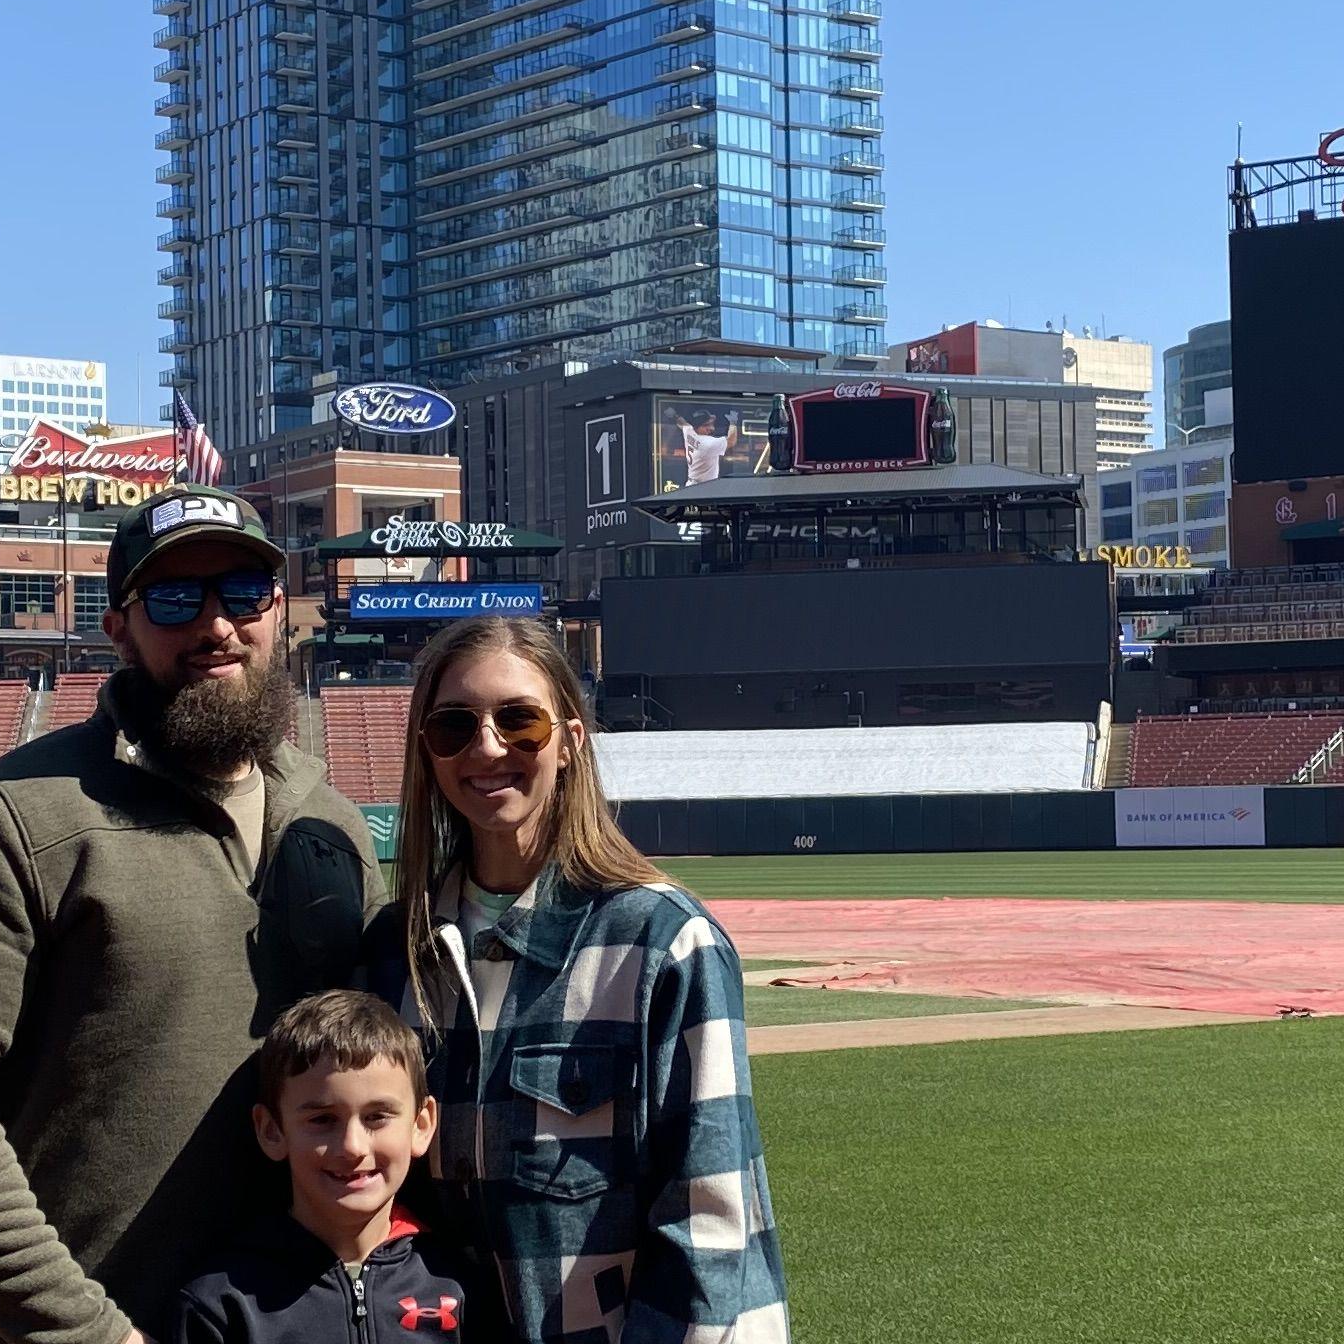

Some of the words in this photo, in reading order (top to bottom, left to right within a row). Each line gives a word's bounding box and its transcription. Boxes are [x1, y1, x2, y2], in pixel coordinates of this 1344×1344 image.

[833, 381, 882, 398] Coca-Cola
[363, 387, 431, 424] Ford
[1, 435, 188, 472] Budweiser
[816, 461, 869, 471] ROOFTOP
[874, 460, 904, 468] DECK
[0, 474, 87, 504] BREW
[97, 476, 174, 506] HOU
[1326, 493, 1336, 520] 1
[386, 515, 438, 531] SCOTT
[467, 523, 506, 535] MVP
[587, 508, 627, 534] phorm
[386, 537, 440, 553] UNION
[467, 535, 514, 547] DECK
[1098, 545, 1192, 568] SMOKE
[356, 593, 411, 609] SCOTT
[414, 592, 477, 609] CREDIT
[480, 592, 536, 608] UNION
[1126, 813, 1156, 822] BANK
[1159, 813, 1172, 822] OF
[1175, 812, 1225, 821] AMERICA
[793, 835, 817, 848] 400'
